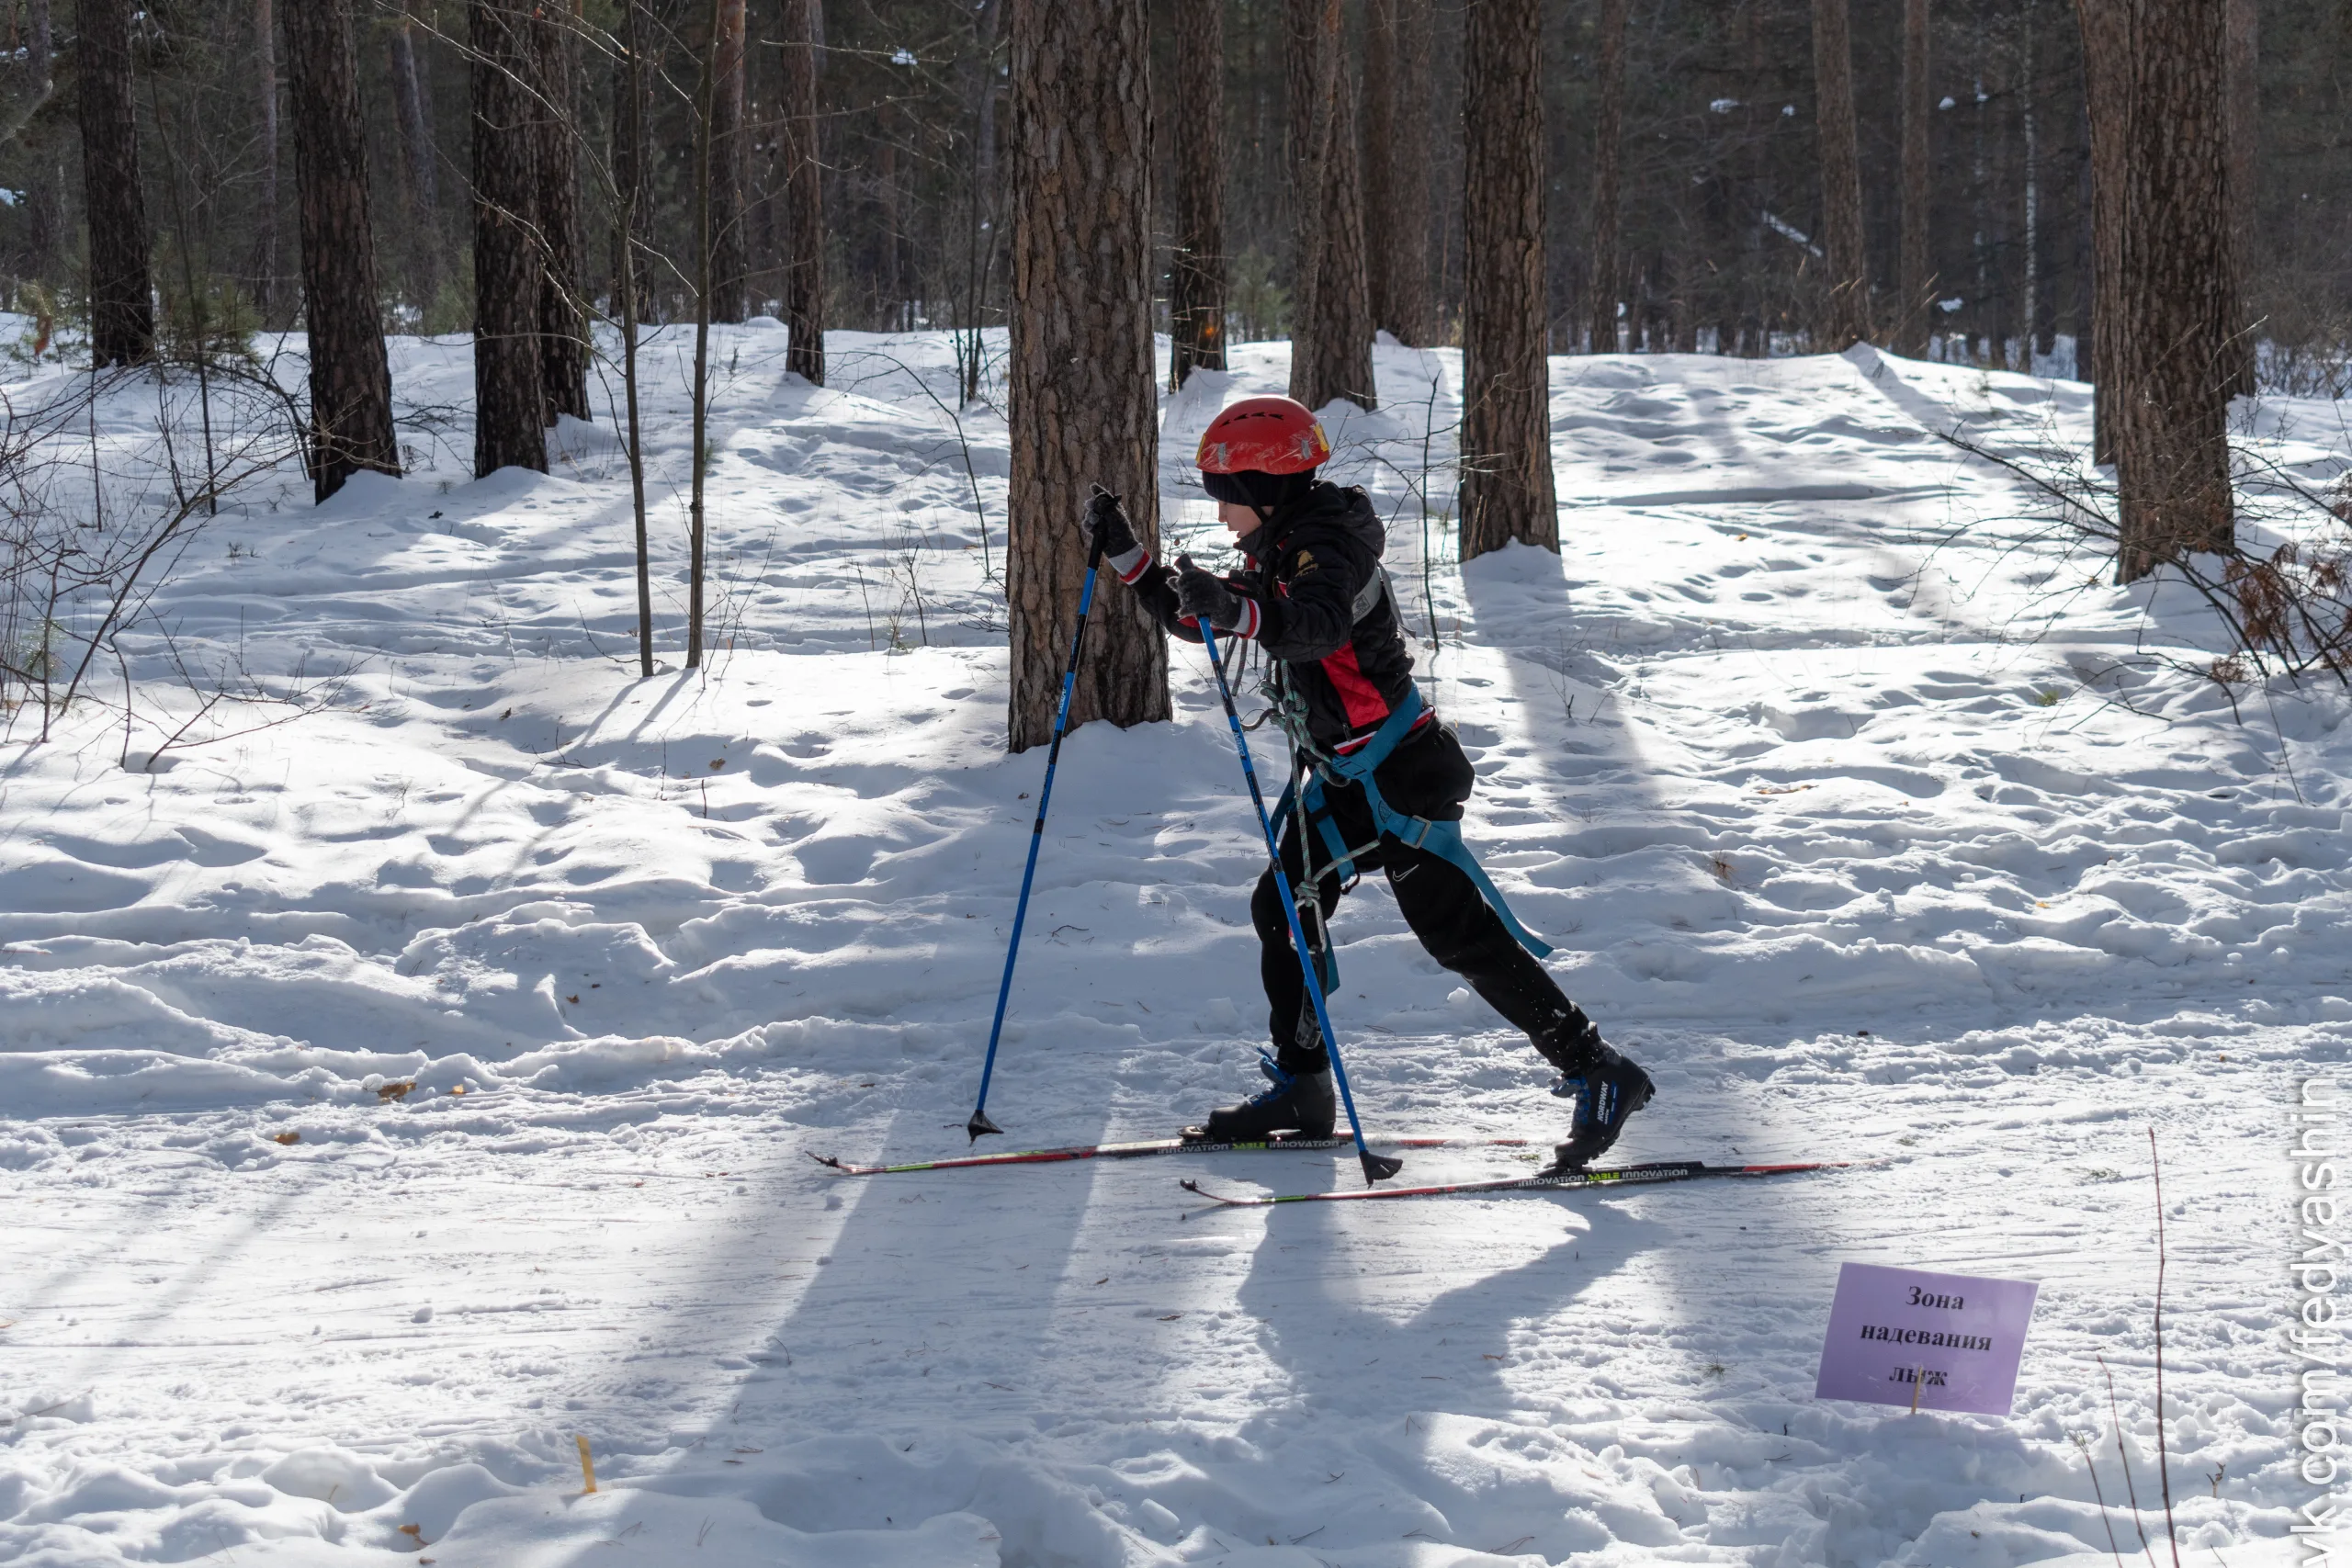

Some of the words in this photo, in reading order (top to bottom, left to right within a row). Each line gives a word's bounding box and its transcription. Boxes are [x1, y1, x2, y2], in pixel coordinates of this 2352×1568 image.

[1597, 1080, 1609, 1122] NORDWAY
[1232, 1142, 1266, 1151] SABLE
[1588, 1171, 1620, 1181] SABLE
[1905, 1286, 1964, 1310] Зона
[1860, 1325, 1992, 1351] надевания
